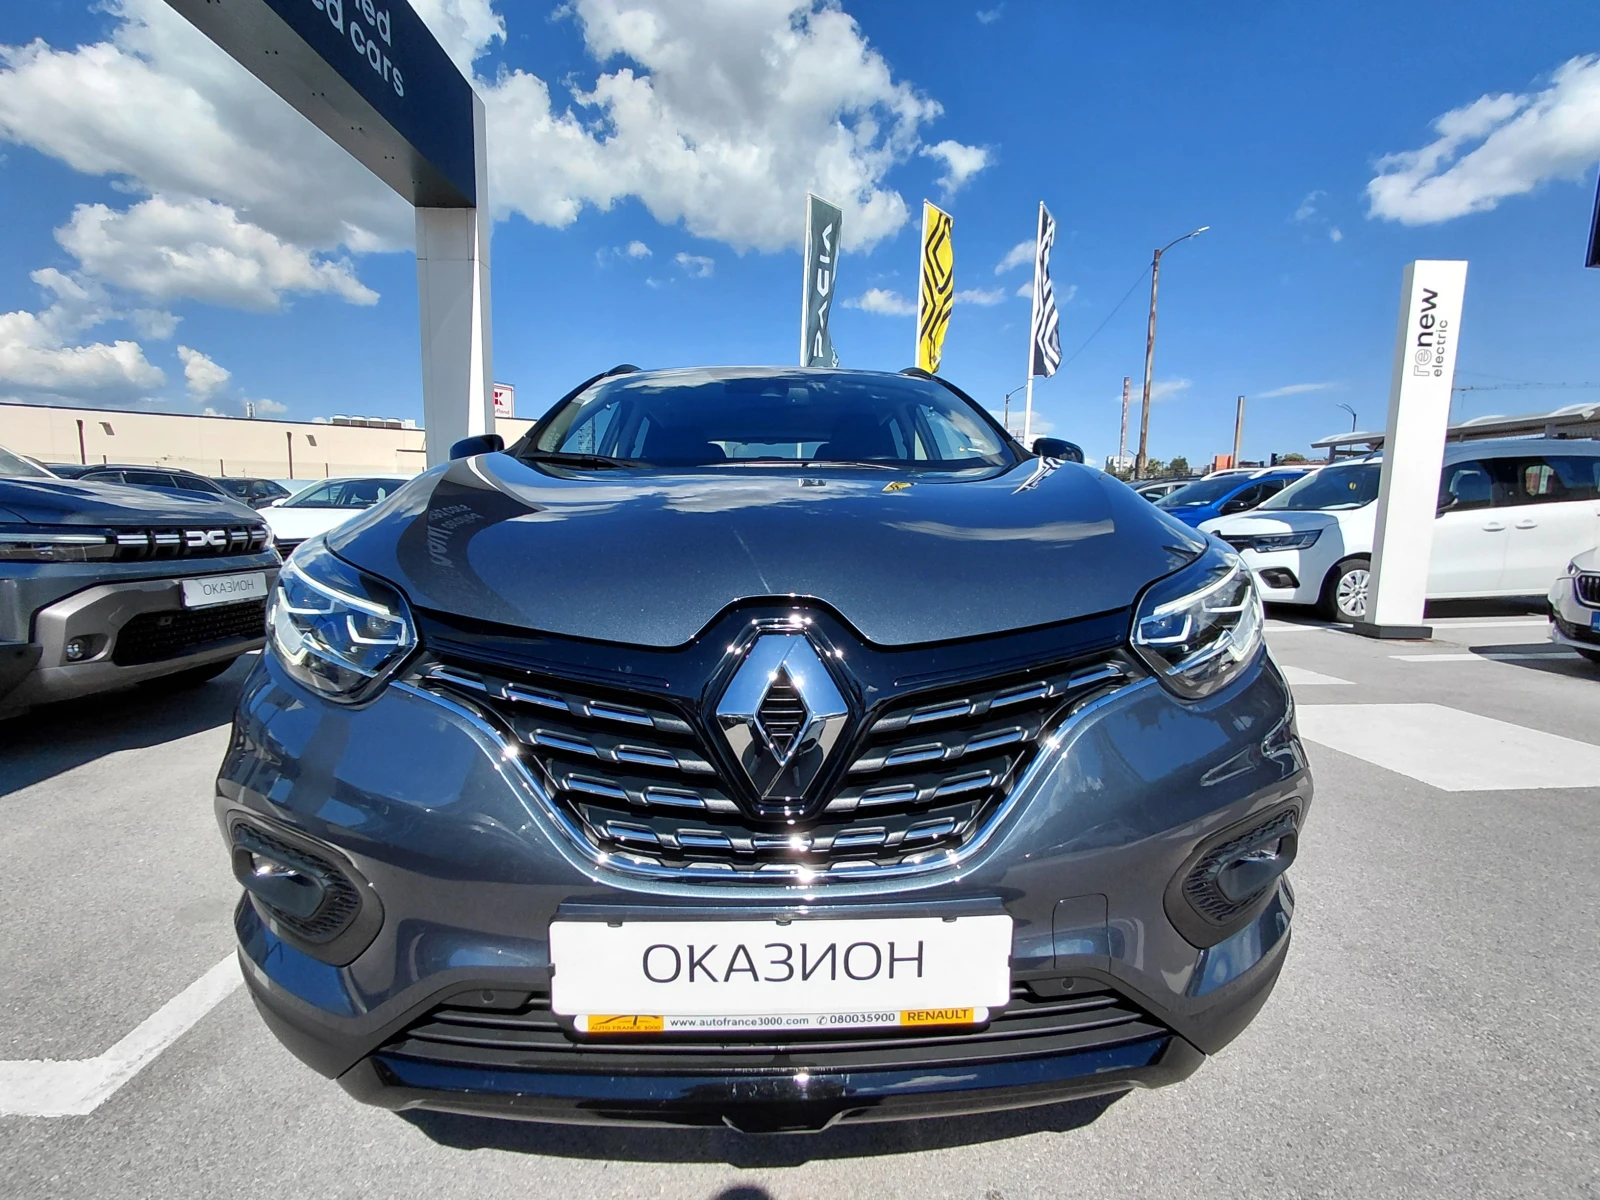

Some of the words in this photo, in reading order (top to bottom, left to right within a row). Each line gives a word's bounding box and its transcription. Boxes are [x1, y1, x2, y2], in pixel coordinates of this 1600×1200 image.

[350, 21, 405, 97] cars
[1413, 288, 1438, 376] renew
[1432, 320, 1448, 377] electric
[203, 580, 255, 596] ОКАЗИОН
[642, 940, 924, 983] ОКАЗИОН
[670, 1016, 809, 1027] www.autofrance3000.com
[829, 1012, 896, 1025] 080035900
[907, 1008, 970, 1022] RENAULT
